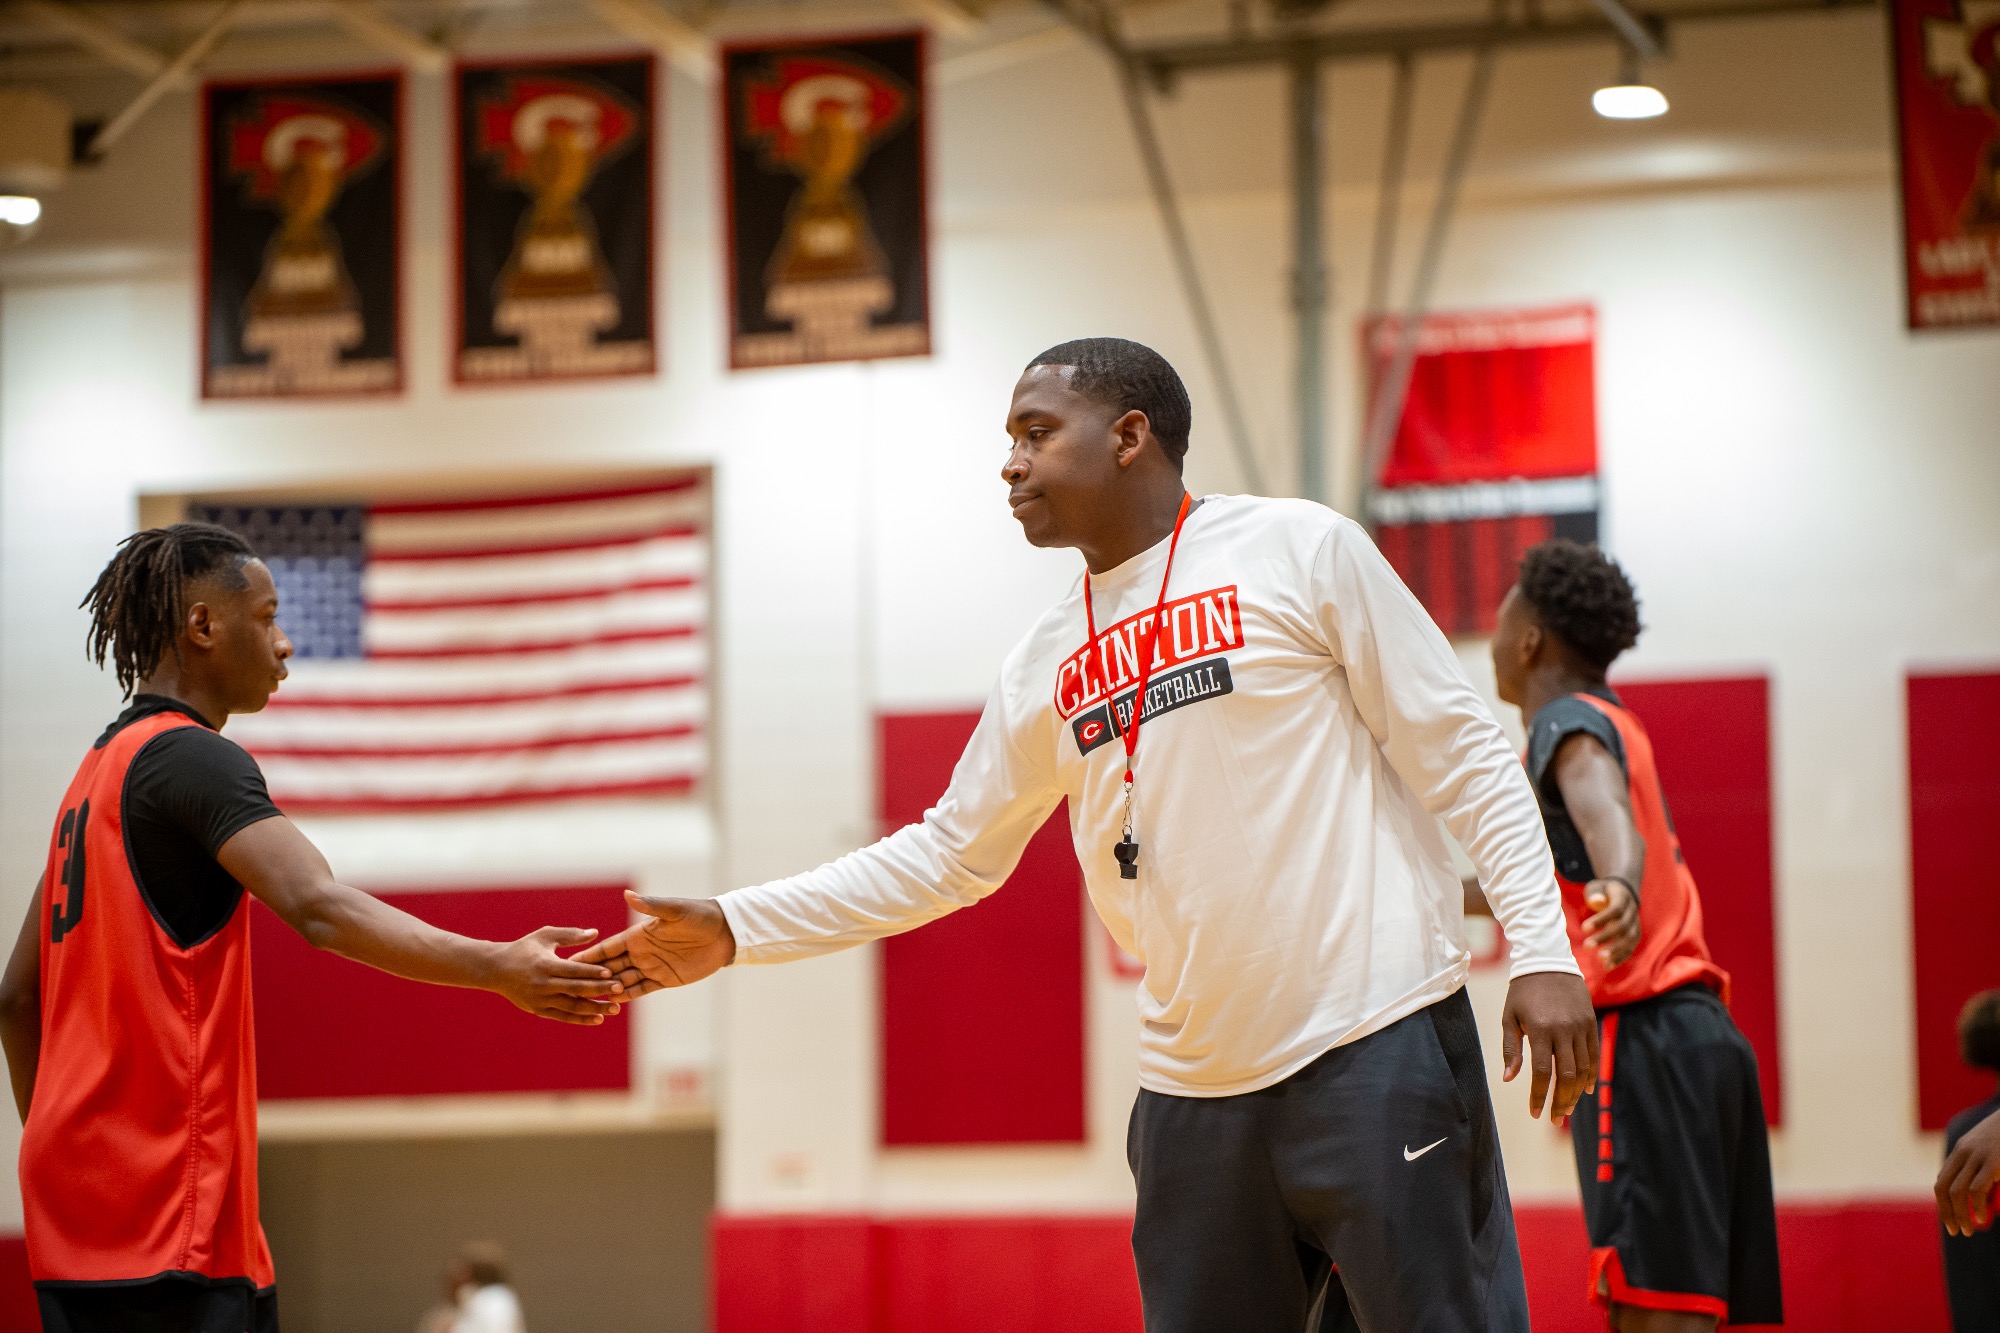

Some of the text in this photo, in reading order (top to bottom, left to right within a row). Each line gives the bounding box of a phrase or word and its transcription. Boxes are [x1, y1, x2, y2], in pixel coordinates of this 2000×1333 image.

[1057, 591, 1236, 716] CLINTON
[1116, 667, 1221, 728] BAKETBALL
[1083, 723, 1100, 740] C
